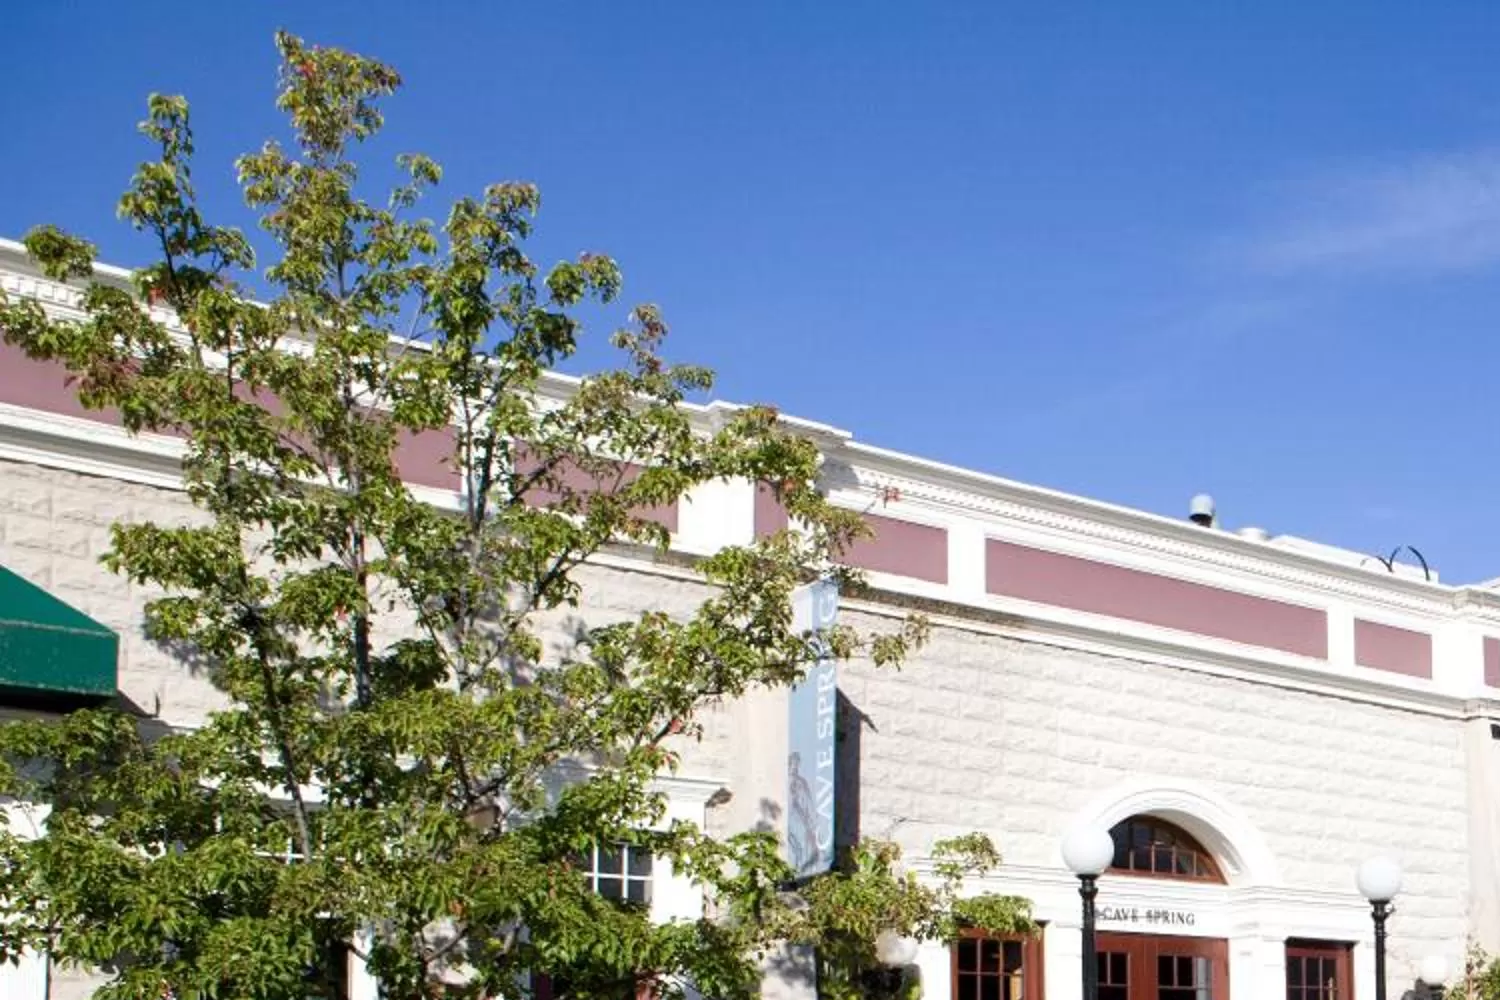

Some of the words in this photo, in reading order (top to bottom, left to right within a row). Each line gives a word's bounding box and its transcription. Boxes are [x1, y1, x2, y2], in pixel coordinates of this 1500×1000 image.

[816, 591, 836, 741] SPRG
[815, 747, 835, 850] CAVE
[1104, 907, 1138, 923] CAVE
[1145, 909, 1195, 926] SPRING
